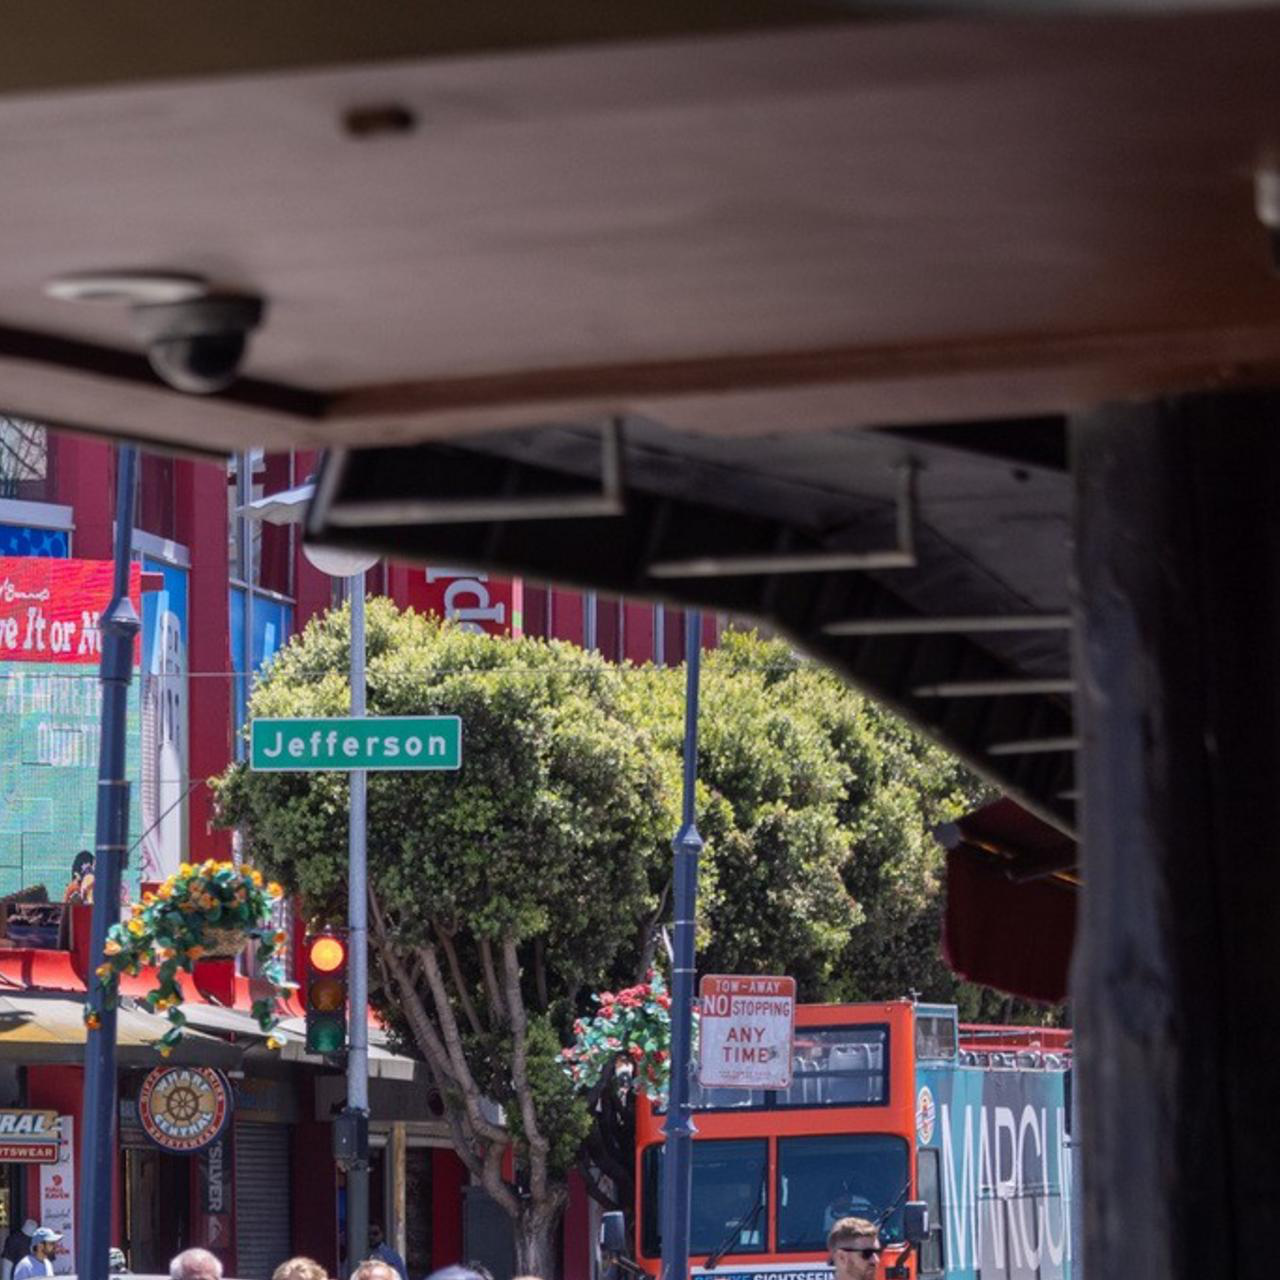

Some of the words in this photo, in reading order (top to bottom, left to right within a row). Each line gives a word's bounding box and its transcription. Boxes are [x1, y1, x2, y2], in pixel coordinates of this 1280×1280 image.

[23, 606, 46, 650] It
[50, 620, 77, 653] or
[263, 731, 447, 757] Jefferson
[715, 980, 781, 992] TOW-AWAY
[703, 994, 730, 1015] NO
[732, 1000, 790, 1017] STOPPING
[726, 1027, 766, 1042] ANY
[722, 1047, 770, 1063] TIME
[155, 1070, 211, 1092] WHARF
